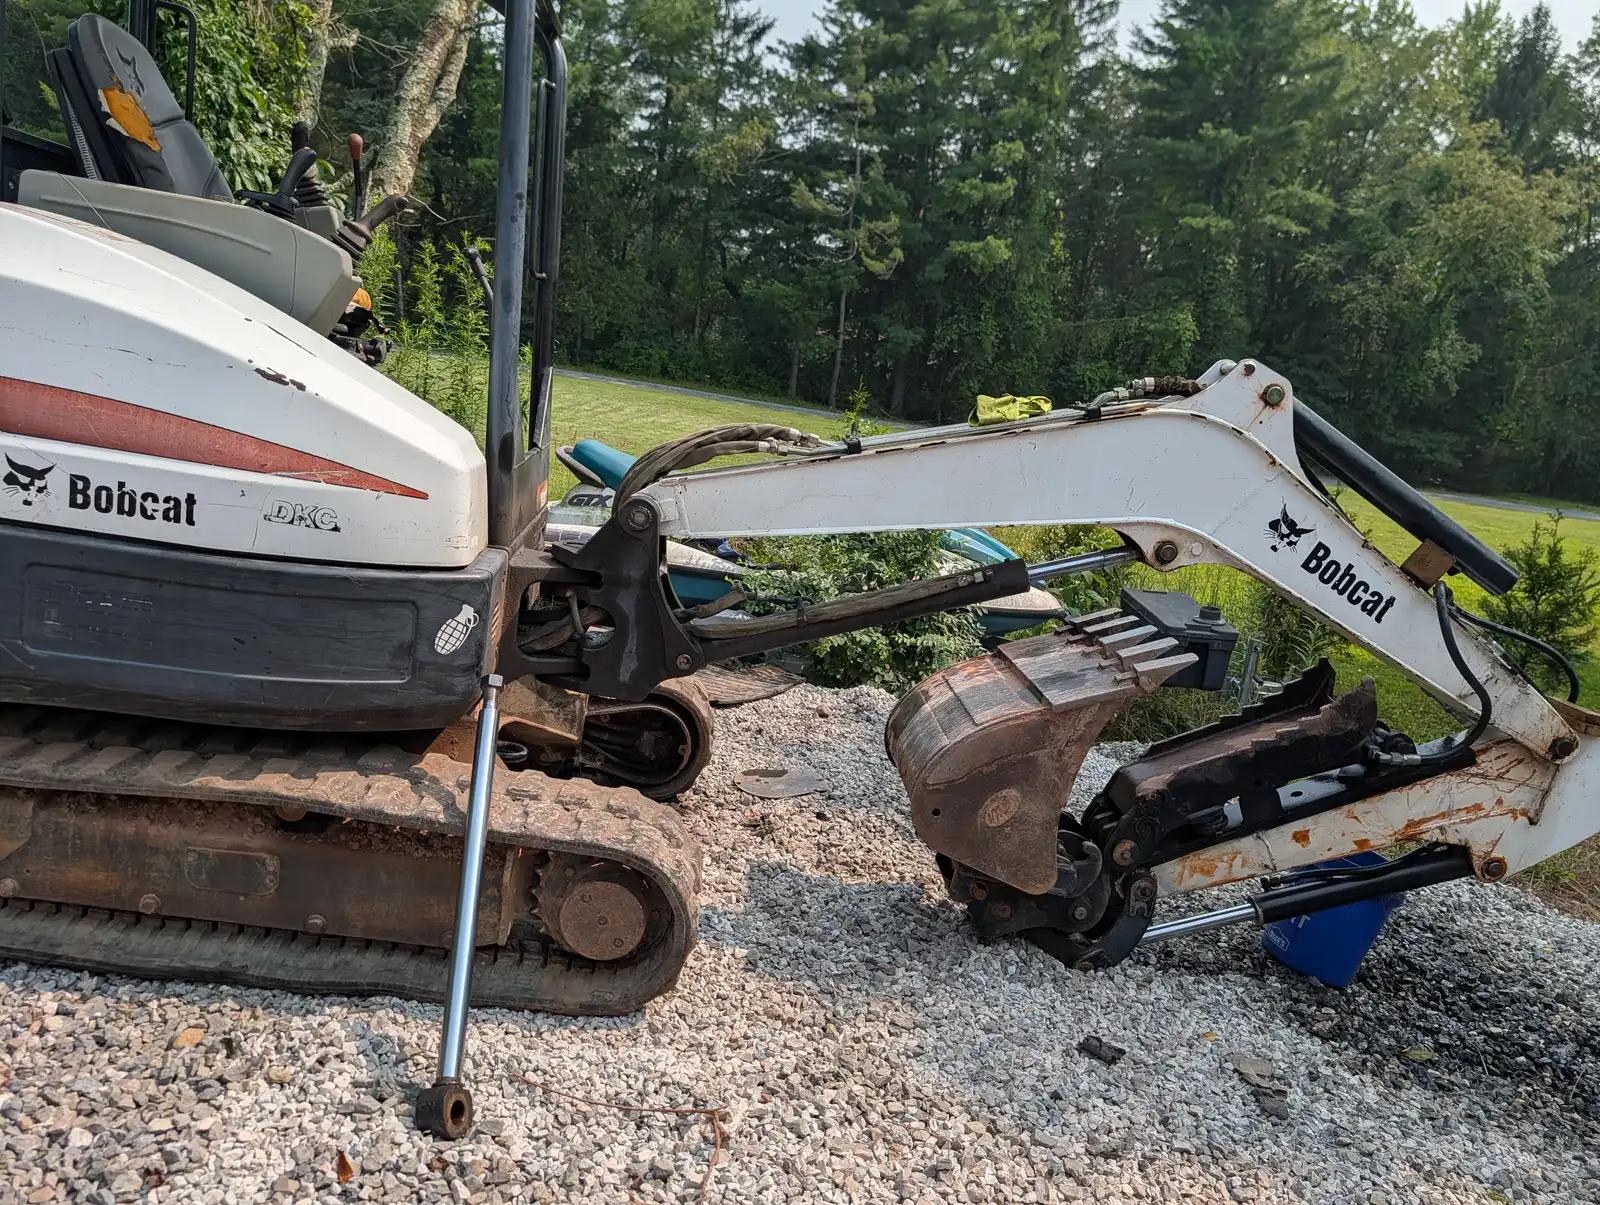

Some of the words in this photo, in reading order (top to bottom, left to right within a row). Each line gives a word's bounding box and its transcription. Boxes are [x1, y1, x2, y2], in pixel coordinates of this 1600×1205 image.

[69, 473, 197, 526] Bobcat
[264, 500, 341, 532] DKC
[568, 494, 613, 507] GTX
[1300, 541, 1396, 624] Bobcat
